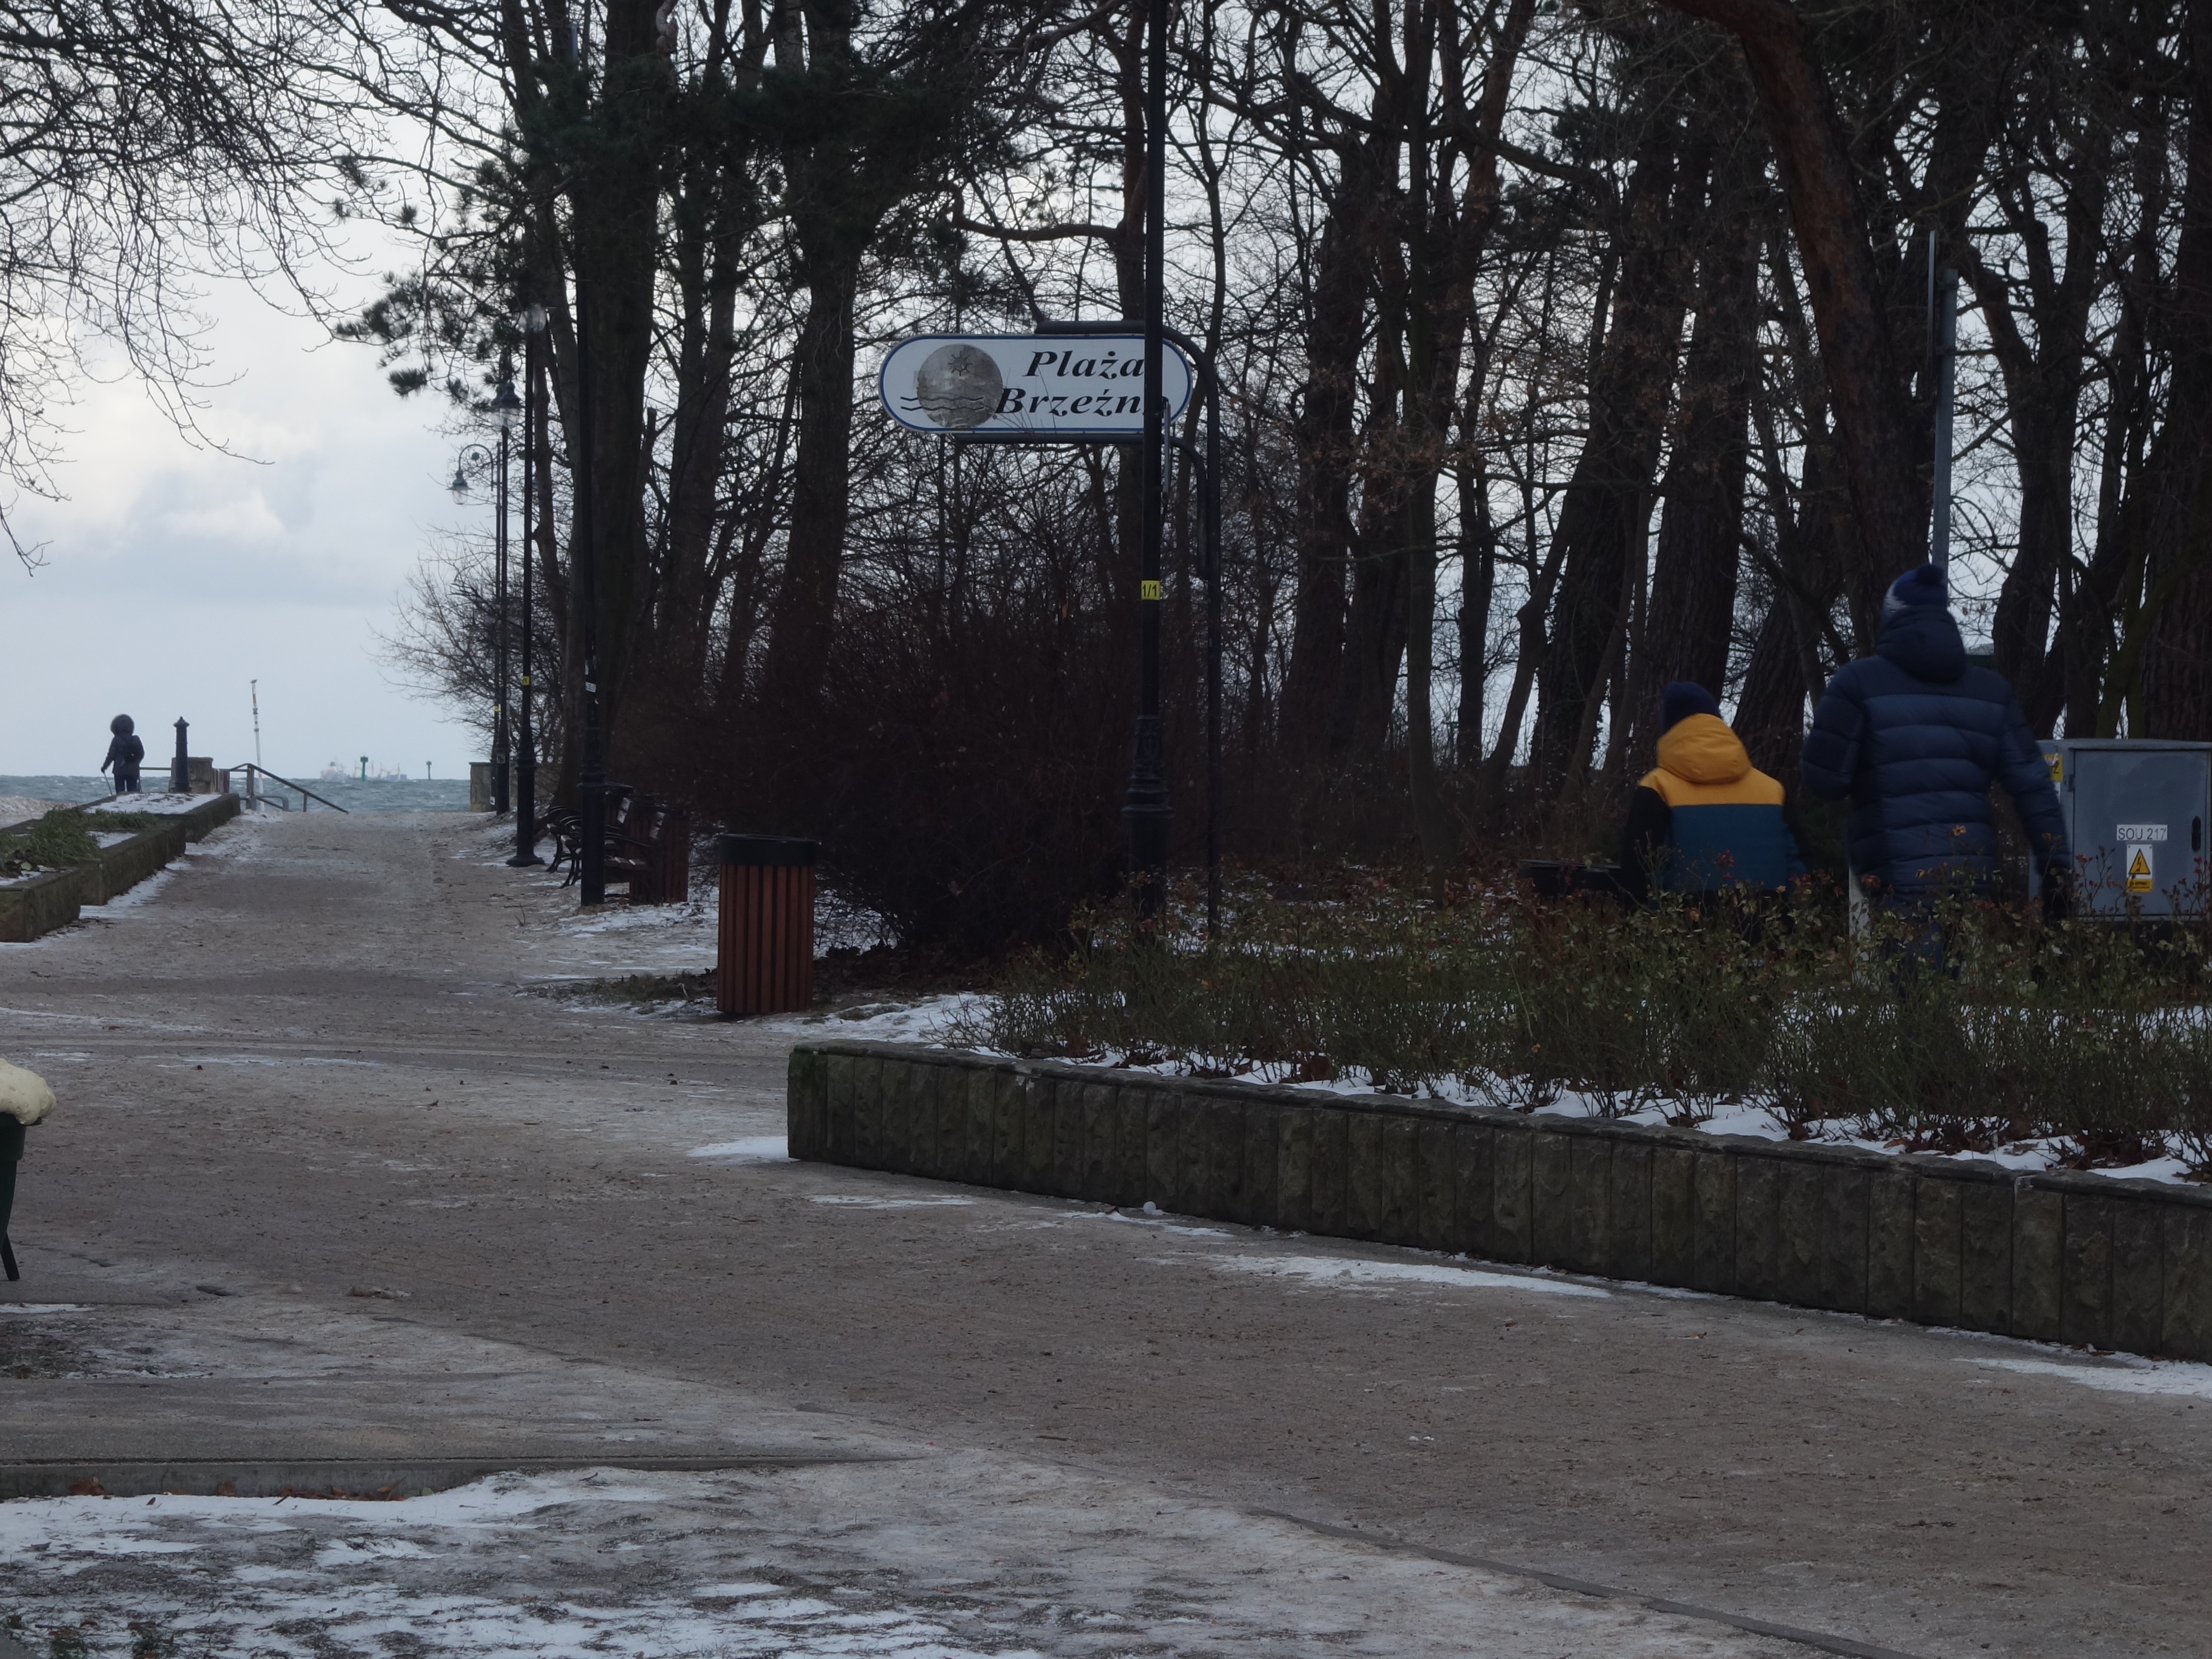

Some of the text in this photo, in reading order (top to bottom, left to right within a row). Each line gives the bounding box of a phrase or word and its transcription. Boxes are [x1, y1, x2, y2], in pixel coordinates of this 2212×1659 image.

[1022, 350, 1145, 379] Plaża
[995, 388, 1169, 417] Brzeźn
[1142, 584, 1157, 597] 1/1
[2118, 828, 2167, 840] SOU 217
